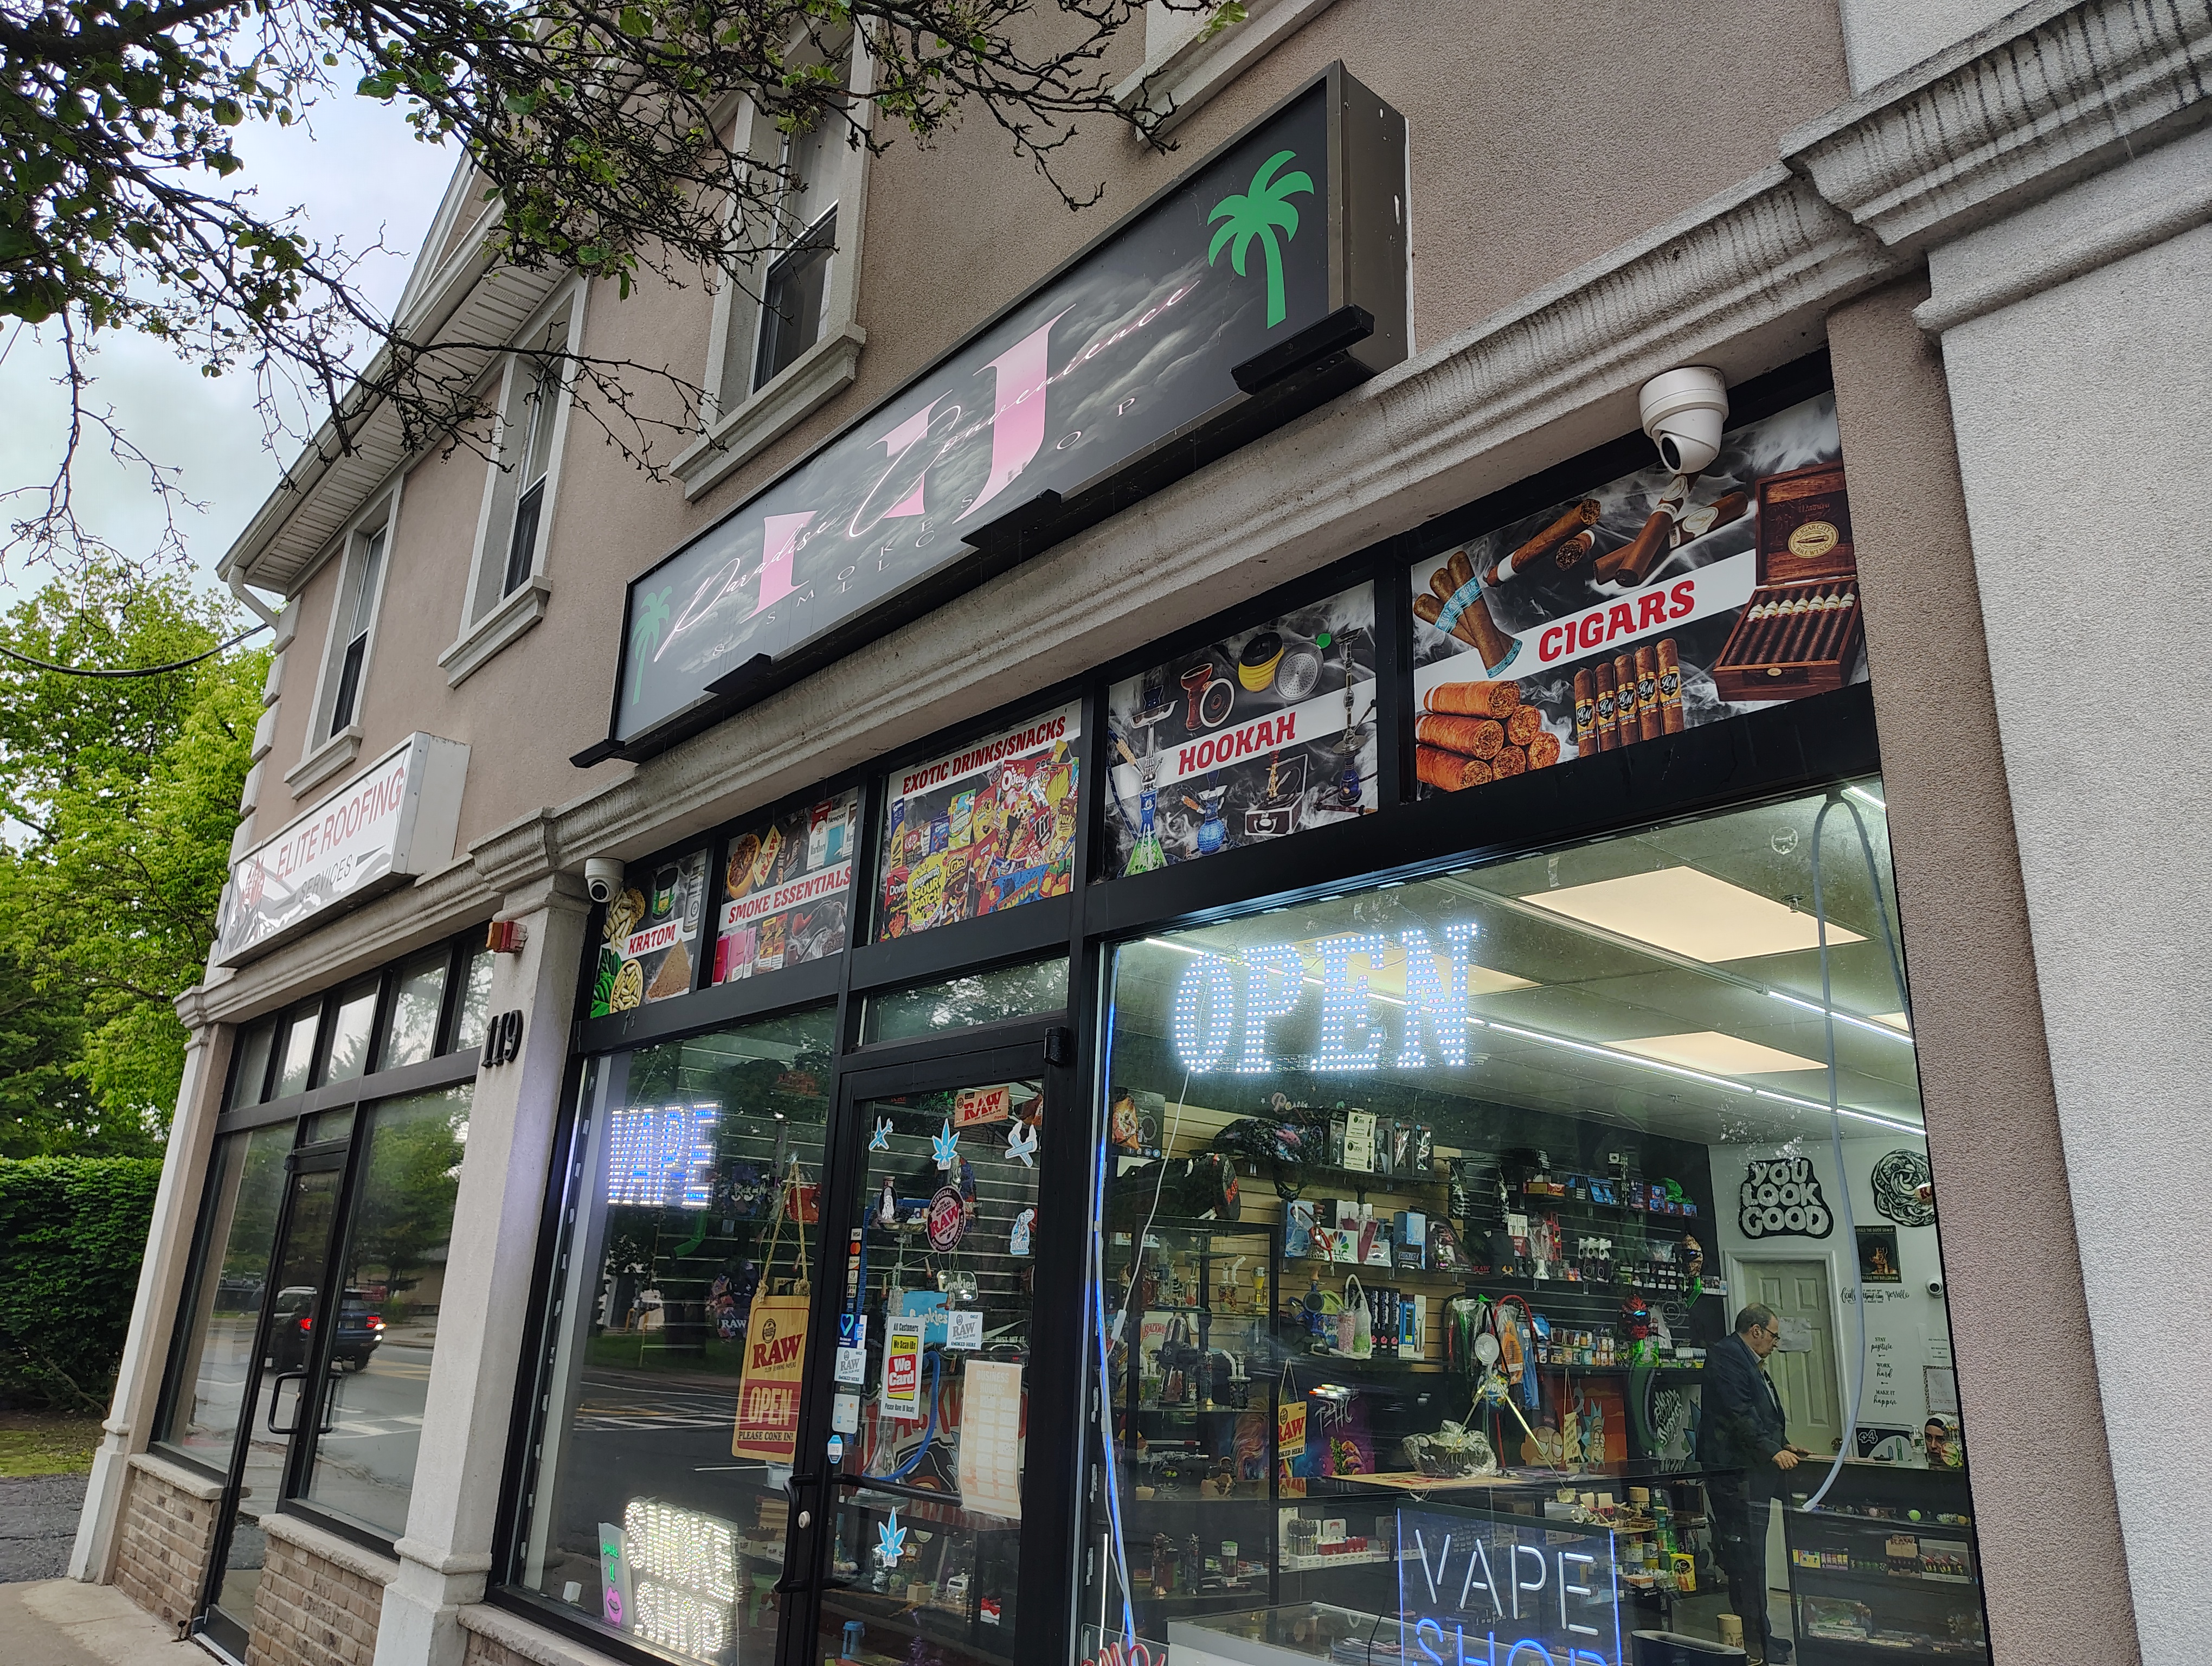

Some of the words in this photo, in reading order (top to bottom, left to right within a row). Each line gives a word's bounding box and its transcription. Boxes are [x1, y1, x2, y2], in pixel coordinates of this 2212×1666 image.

[653, 517, 837, 663] Paradise
[847, 280, 1201, 538] Convenience
[1796, 525, 1816, 537] CIGAR
[1817, 524, 1831, 533] CITY
[1795, 543, 1831, 556] BREWING
[1539, 580, 1695, 662] CIGARS
[903, 761, 949, 795] EXOTIC
[952, 716, 1066, 777] DRINKS/SNACKS
[1178, 711, 1297, 775] HOOKAH
[276, 823, 320, 882] ELITE
[319, 766, 404, 854] ROOFING
[828, 812, 847, 824] Newport
[299, 854, 353, 902] SERVICES
[915, 877, 940, 899] SOUR
[729, 896, 770, 924] SMOKE
[773, 866, 851, 909] ESSENTIALS
[913, 888, 941, 915] PATCH
[628, 924, 677, 955] KRATOM
[1174, 924, 1477, 1073] OPEN
[481, 1009, 524, 1068] 119
[964, 1091, 1004, 1122] RAW
[607, 1103, 719, 1208] VAPE
[1750, 1159, 1809, 1187] YOU
[1742, 1182, 1822, 1208] LOOK
[929, 1203, 960, 1239] RAW
[1741, 1205, 1830, 1237] GOOD
[941, 1272, 976, 1293] Cookies
[721, 1319, 747, 1329] RAW
[899, 1323, 919, 1332] Customers
[953, 1322, 976, 1338] RAW
[752, 1334, 803, 1369] RAW
[1870, 1343, 1893, 1354] positive
[840, 1358, 860, 1372] RAW
[889, 1370, 915, 1386] Card
[893, 1357, 911, 1373] We
[976, 1369, 1010, 1383] BUSINESS
[1876, 1367, 1893, 1378] hard
[980, 1382, 1005, 1396] HOURS:
[1873, 1394, 1898, 1408] happen
[748, 1386, 793, 1426] OPEN
[738, 1431, 763, 1440] PLEASE
[783, 1432, 794, 1441] IN!
[1278, 1416, 1306, 1442] RAW
[1415, 1528, 1599, 1636] VAPE
